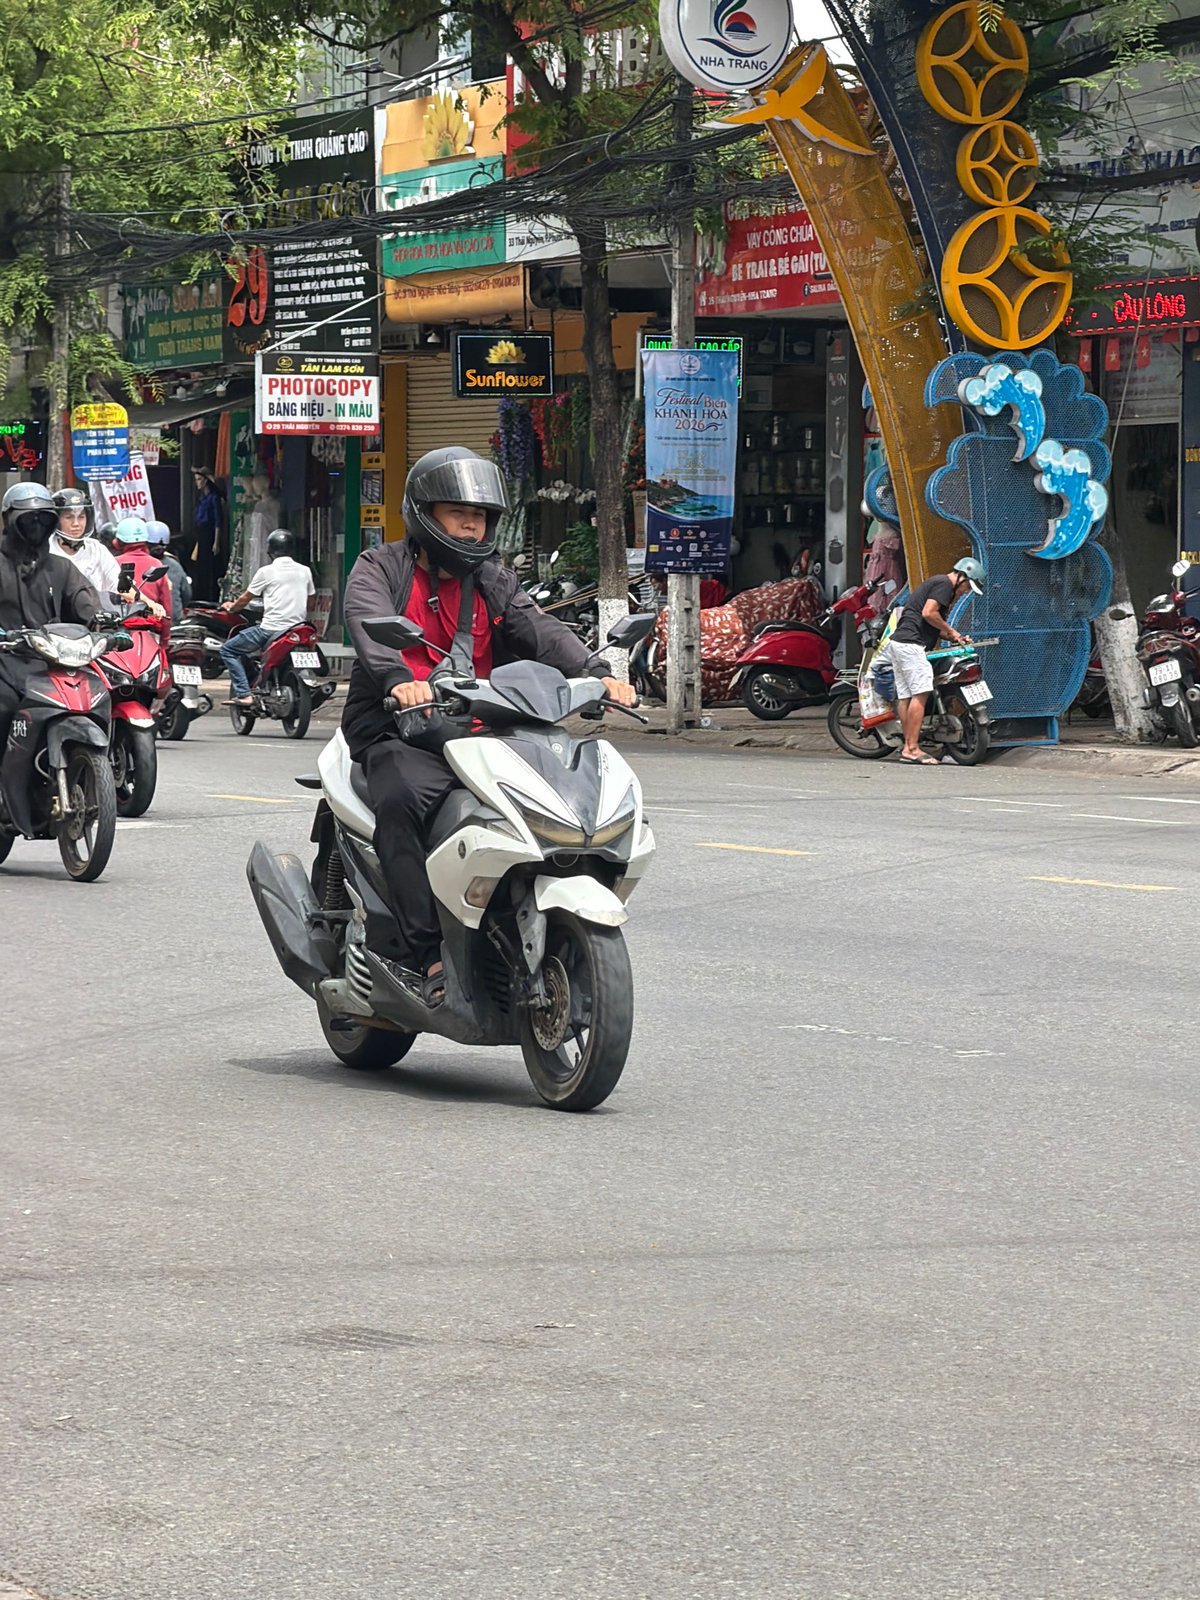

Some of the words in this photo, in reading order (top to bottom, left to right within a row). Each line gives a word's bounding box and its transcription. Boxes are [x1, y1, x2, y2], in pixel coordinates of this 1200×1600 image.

[700, 56, 725, 67] NHA
[728, 58, 768, 71] TRANG
[290, 138, 313, 160] TNHH
[315, 129, 345, 160] QUẢNG
[348, 127, 366, 154] CÁO
[763, 225, 789, 246] CÔNG
[790, 220, 814, 243] CHÚA
[746, 260, 768, 280] TRAI
[778, 252, 790, 276] BÉ
[791, 249, 809, 274] GÁI
[1114, 292, 1143, 323] CẦU
[1146, 292, 1186, 319] LÔNG
[301, 363, 320, 373] TÂN
[321, 365, 342, 373] LAM
[343, 364, 364, 373] SƠN
[465, 369, 546, 387] Sunflower
[268, 377, 372, 397] PHOTOCOPY
[655, 387, 704, 407] Festival
[268, 397, 297, 417] BẢNG
[301, 399, 324, 420] HIỆU
[335, 402, 345, 417] IN
[349, 400, 372, 418] MÀU
[655, 407, 697, 418] KHÁNH
[702, 408, 728, 420] HÒA
[675, 419, 705, 431] 2026
[109, 491, 147, 511] PHỤC
